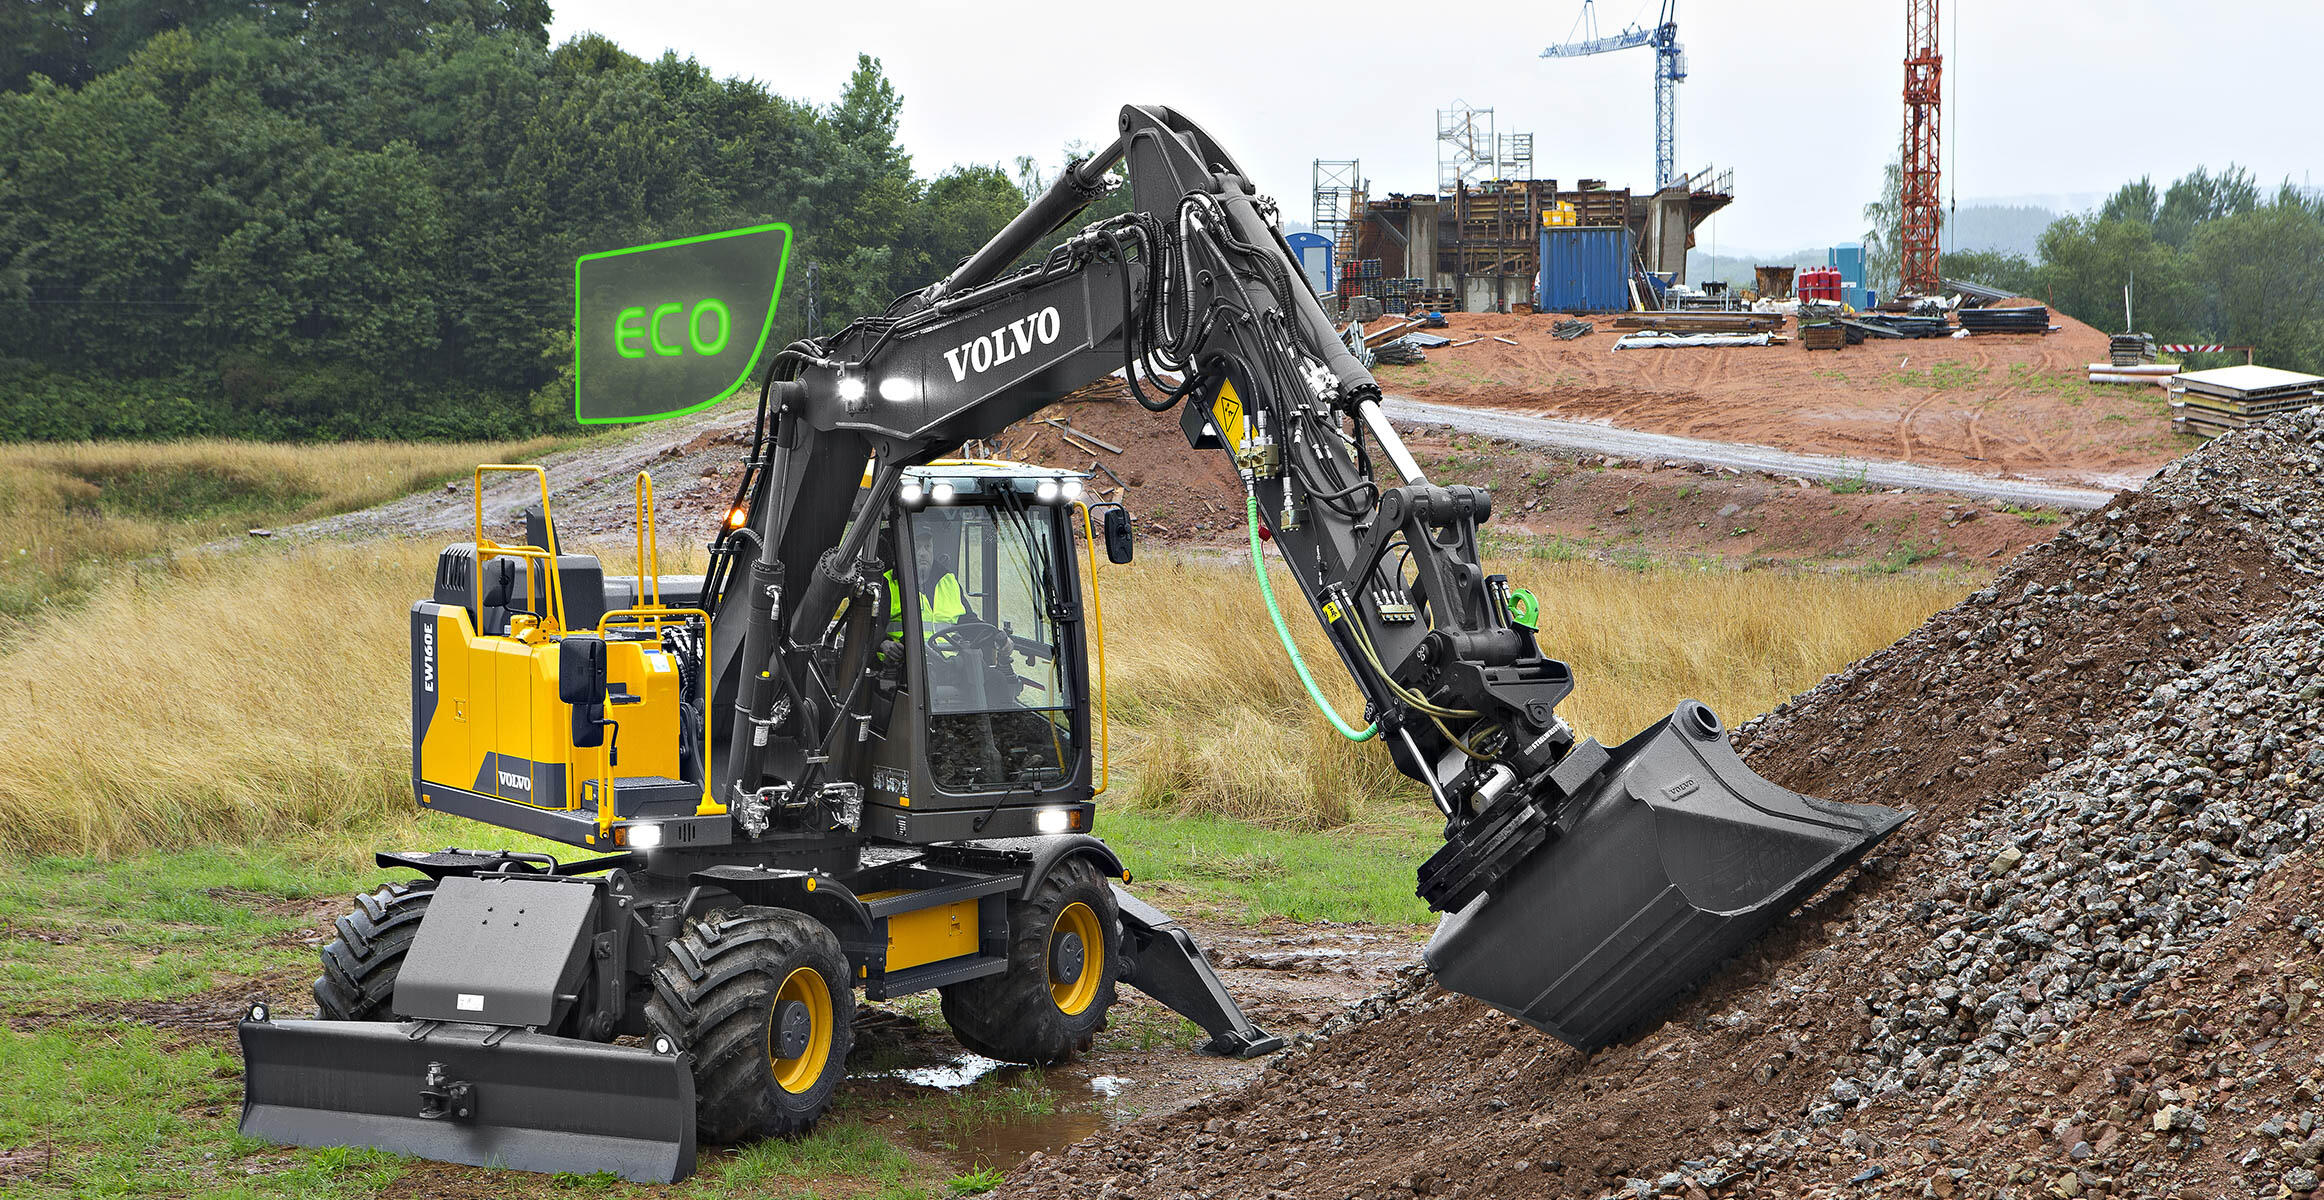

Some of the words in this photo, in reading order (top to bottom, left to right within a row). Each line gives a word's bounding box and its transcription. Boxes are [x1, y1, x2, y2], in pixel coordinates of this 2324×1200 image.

[943, 306, 1060, 383] VOLVO
[423, 623, 434, 692] EW160E
[498, 770, 531, 791] VOLVO
[1669, 779, 1694, 795] VOLVO
